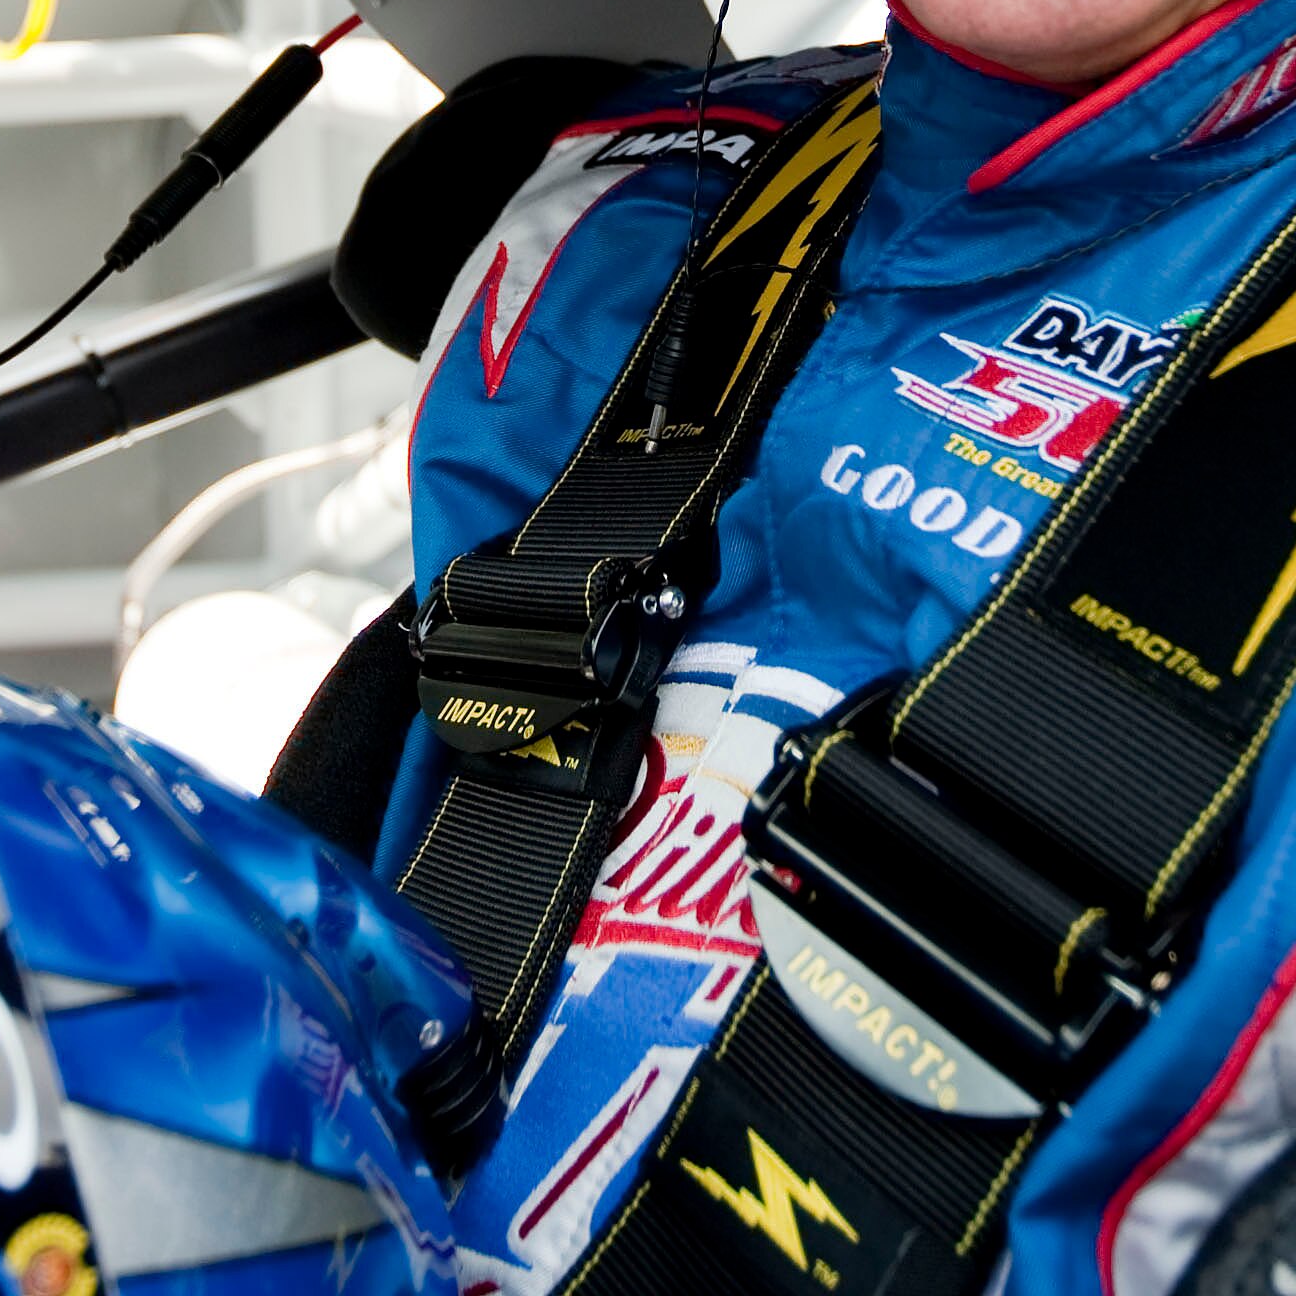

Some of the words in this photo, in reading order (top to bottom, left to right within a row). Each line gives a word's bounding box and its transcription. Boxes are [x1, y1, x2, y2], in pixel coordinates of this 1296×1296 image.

[597, 129, 756, 168] IMPA
[1003, 298, 1180, 393] DAY
[944, 433, 992, 466] The
[820, 444, 1023, 558] GOOD
